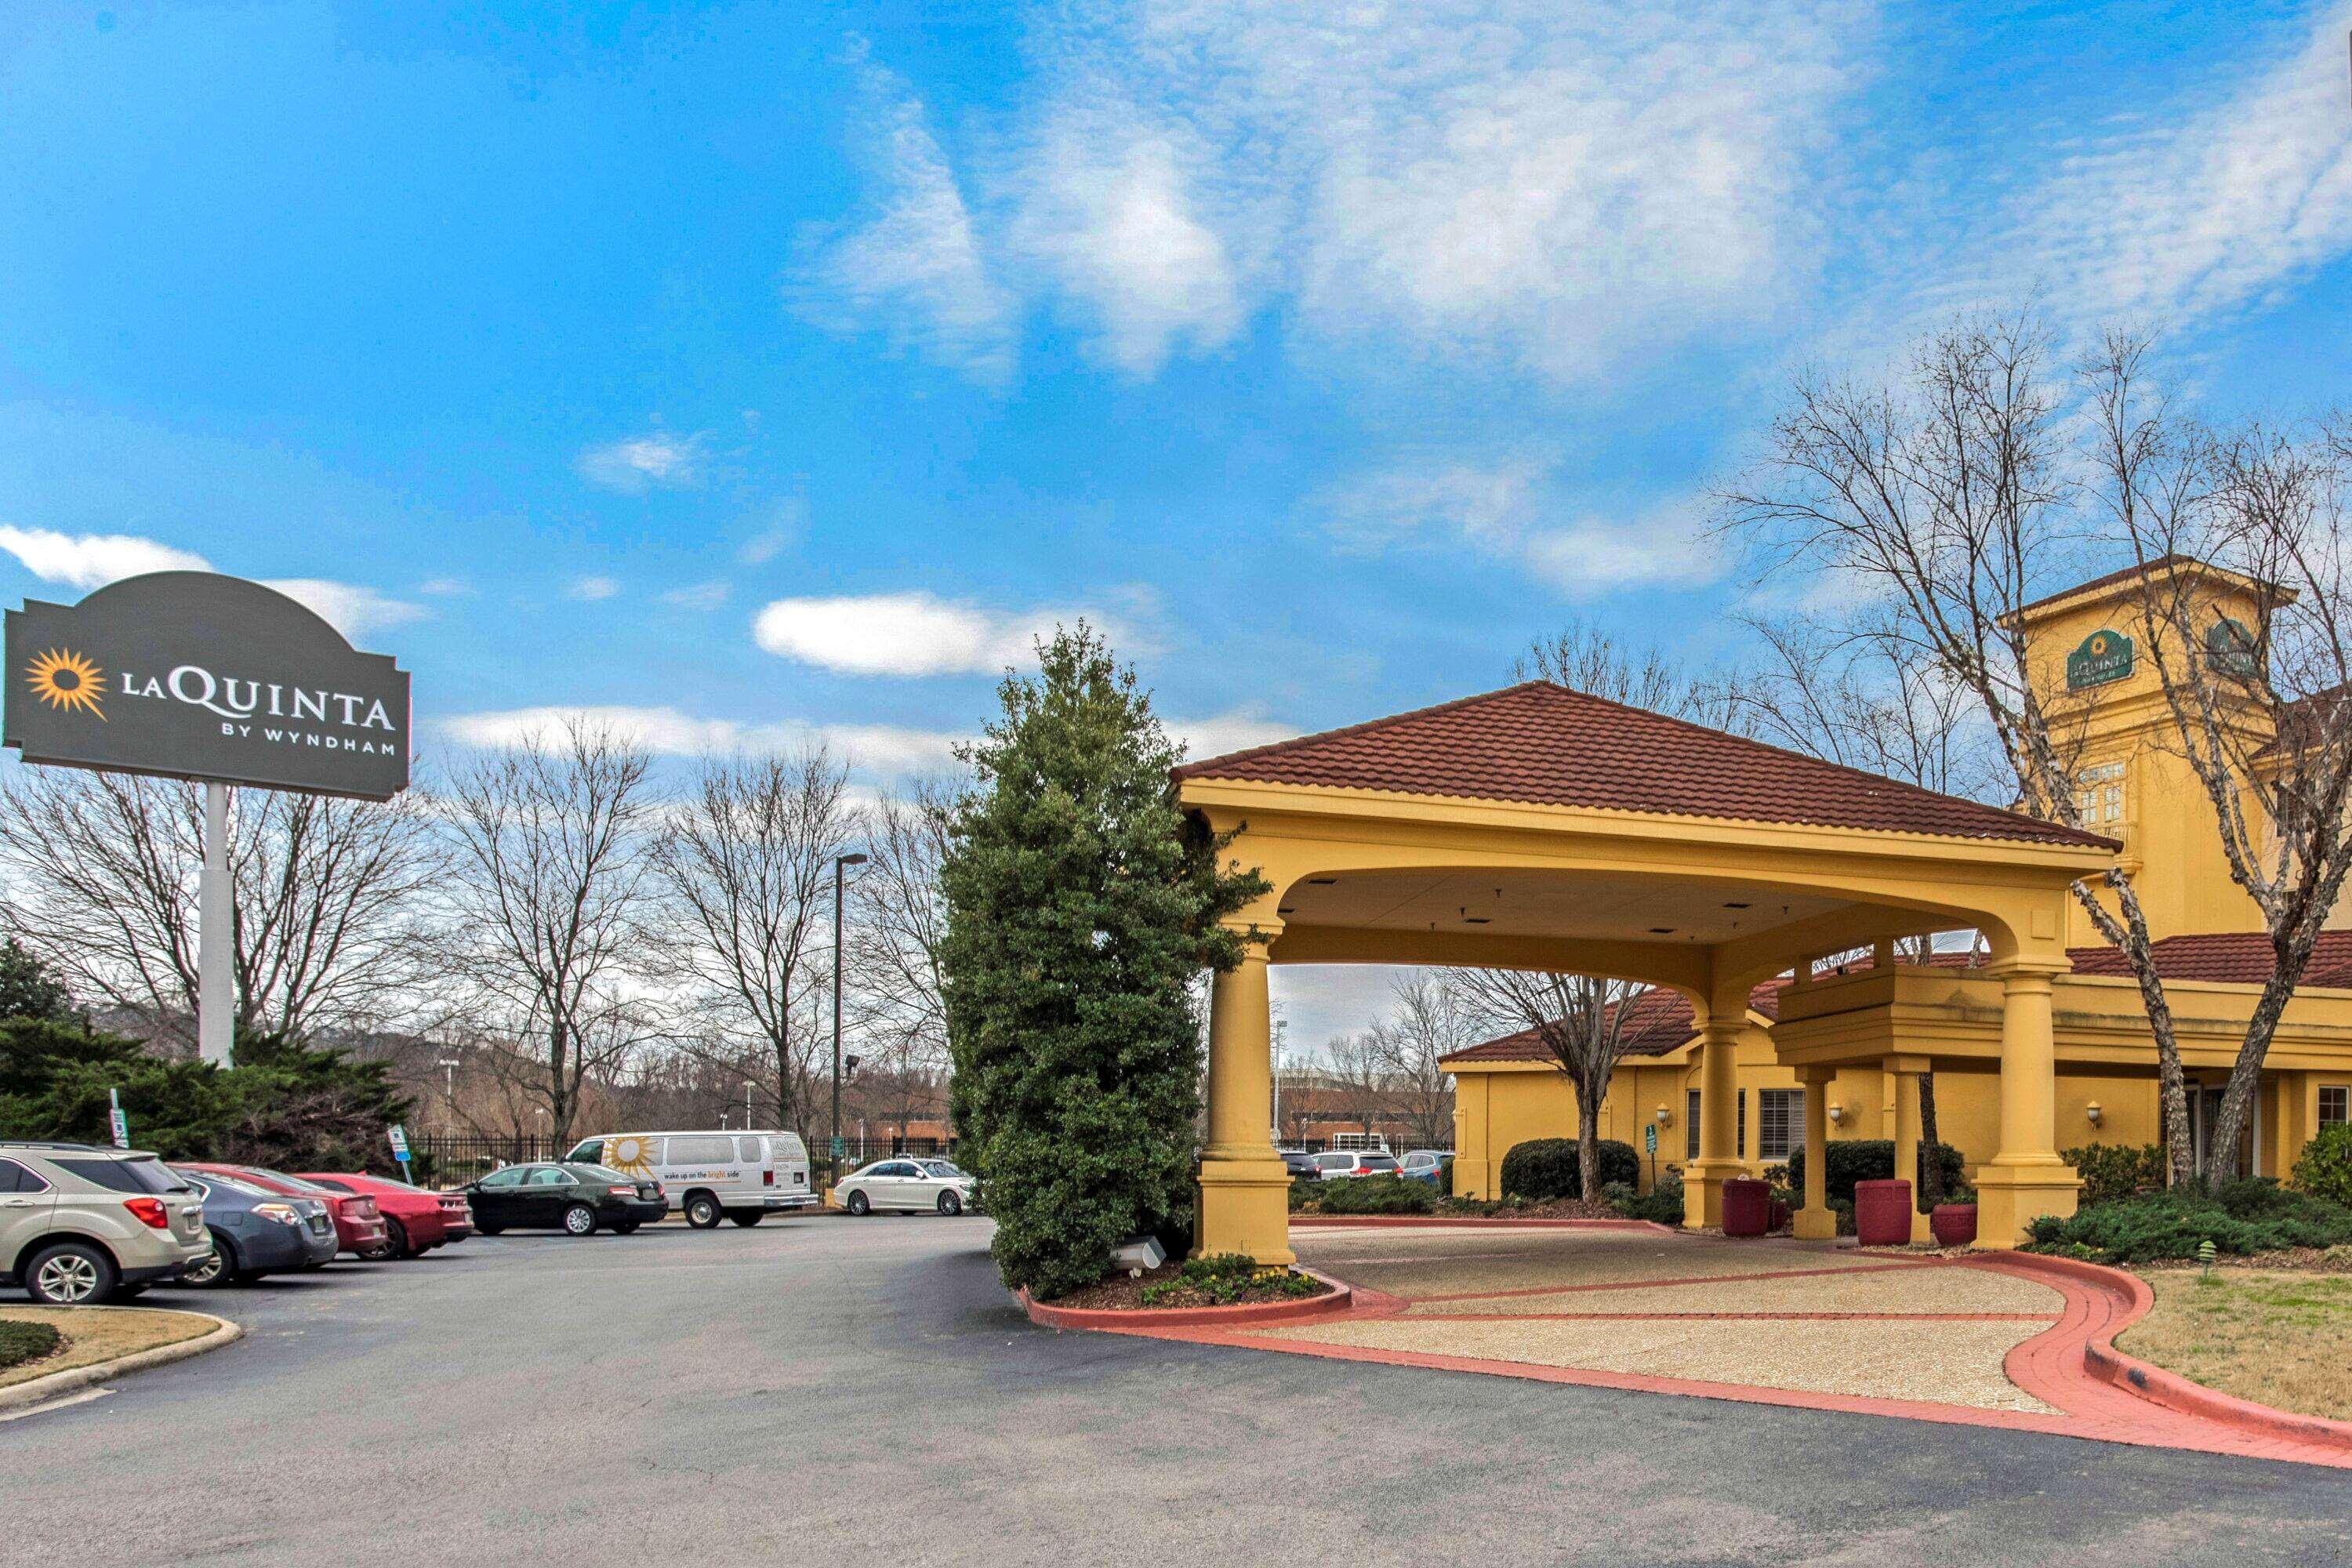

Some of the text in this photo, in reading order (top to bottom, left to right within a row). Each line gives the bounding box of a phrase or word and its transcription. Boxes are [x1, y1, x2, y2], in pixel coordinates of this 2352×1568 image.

[221, 722, 396, 756] BY WYNDHAM
[664, 1171, 680, 1180] wake
[681, 1173, 688, 1181] up
[708, 1171, 726, 1180] bright
